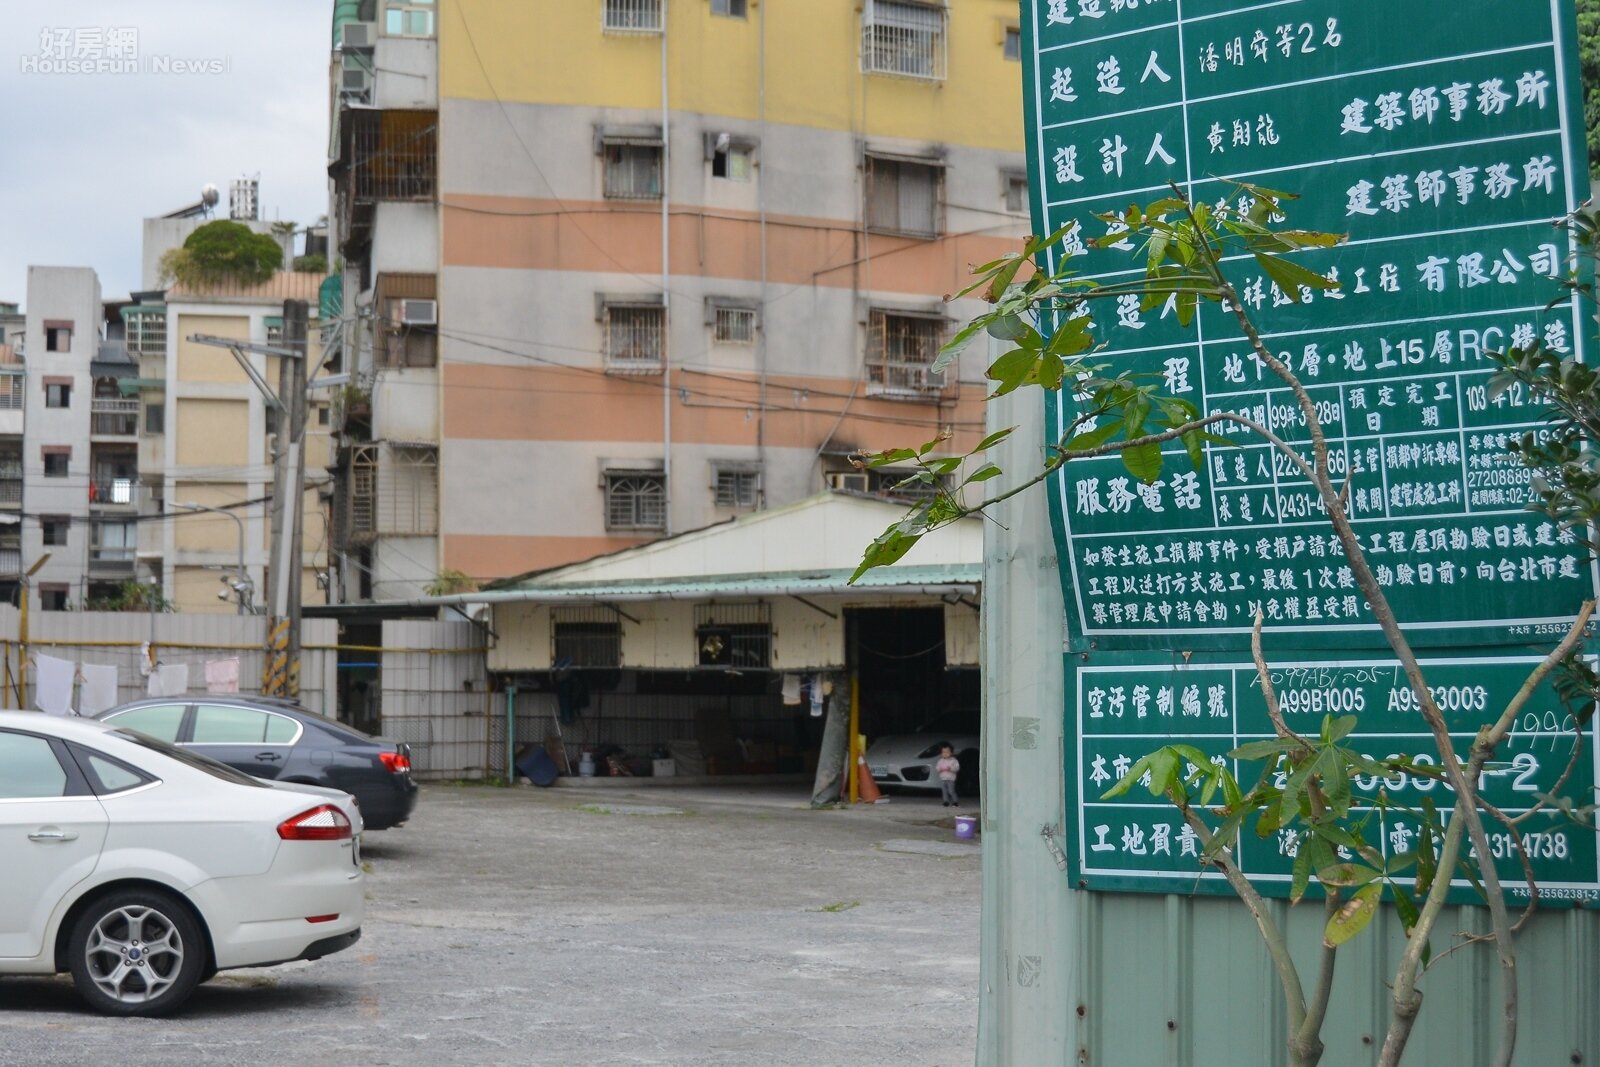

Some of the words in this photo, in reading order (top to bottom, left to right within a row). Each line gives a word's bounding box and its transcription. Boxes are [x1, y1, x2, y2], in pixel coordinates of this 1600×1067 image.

[1199, 17, 1342, 73] 潘明舜等2名
[1050, 51, 1171, 102] 起造人
[1340, 70, 1549, 136] 建築師事務所
[1053, 133, 1176, 184] 設計人
[1346, 156, 1556, 216] 建築師事務所
[1416, 244, 1560, 292] 有限公司
[1349, 382, 1452, 409] 預定完工
[1271, 400, 1340, 429] 99年328日
[1366, 406, 1439, 432] 日期
[1214, 453, 1270, 482] 監造人
[1353, 448, 1379, 473] 主管
[1076, 471, 1201, 516] 服務電話
[1219, 494, 1275, 522] 承造人
[1279, 687, 1365, 713] A99B1005
[1090, 823, 1231, 858] 工地負責
